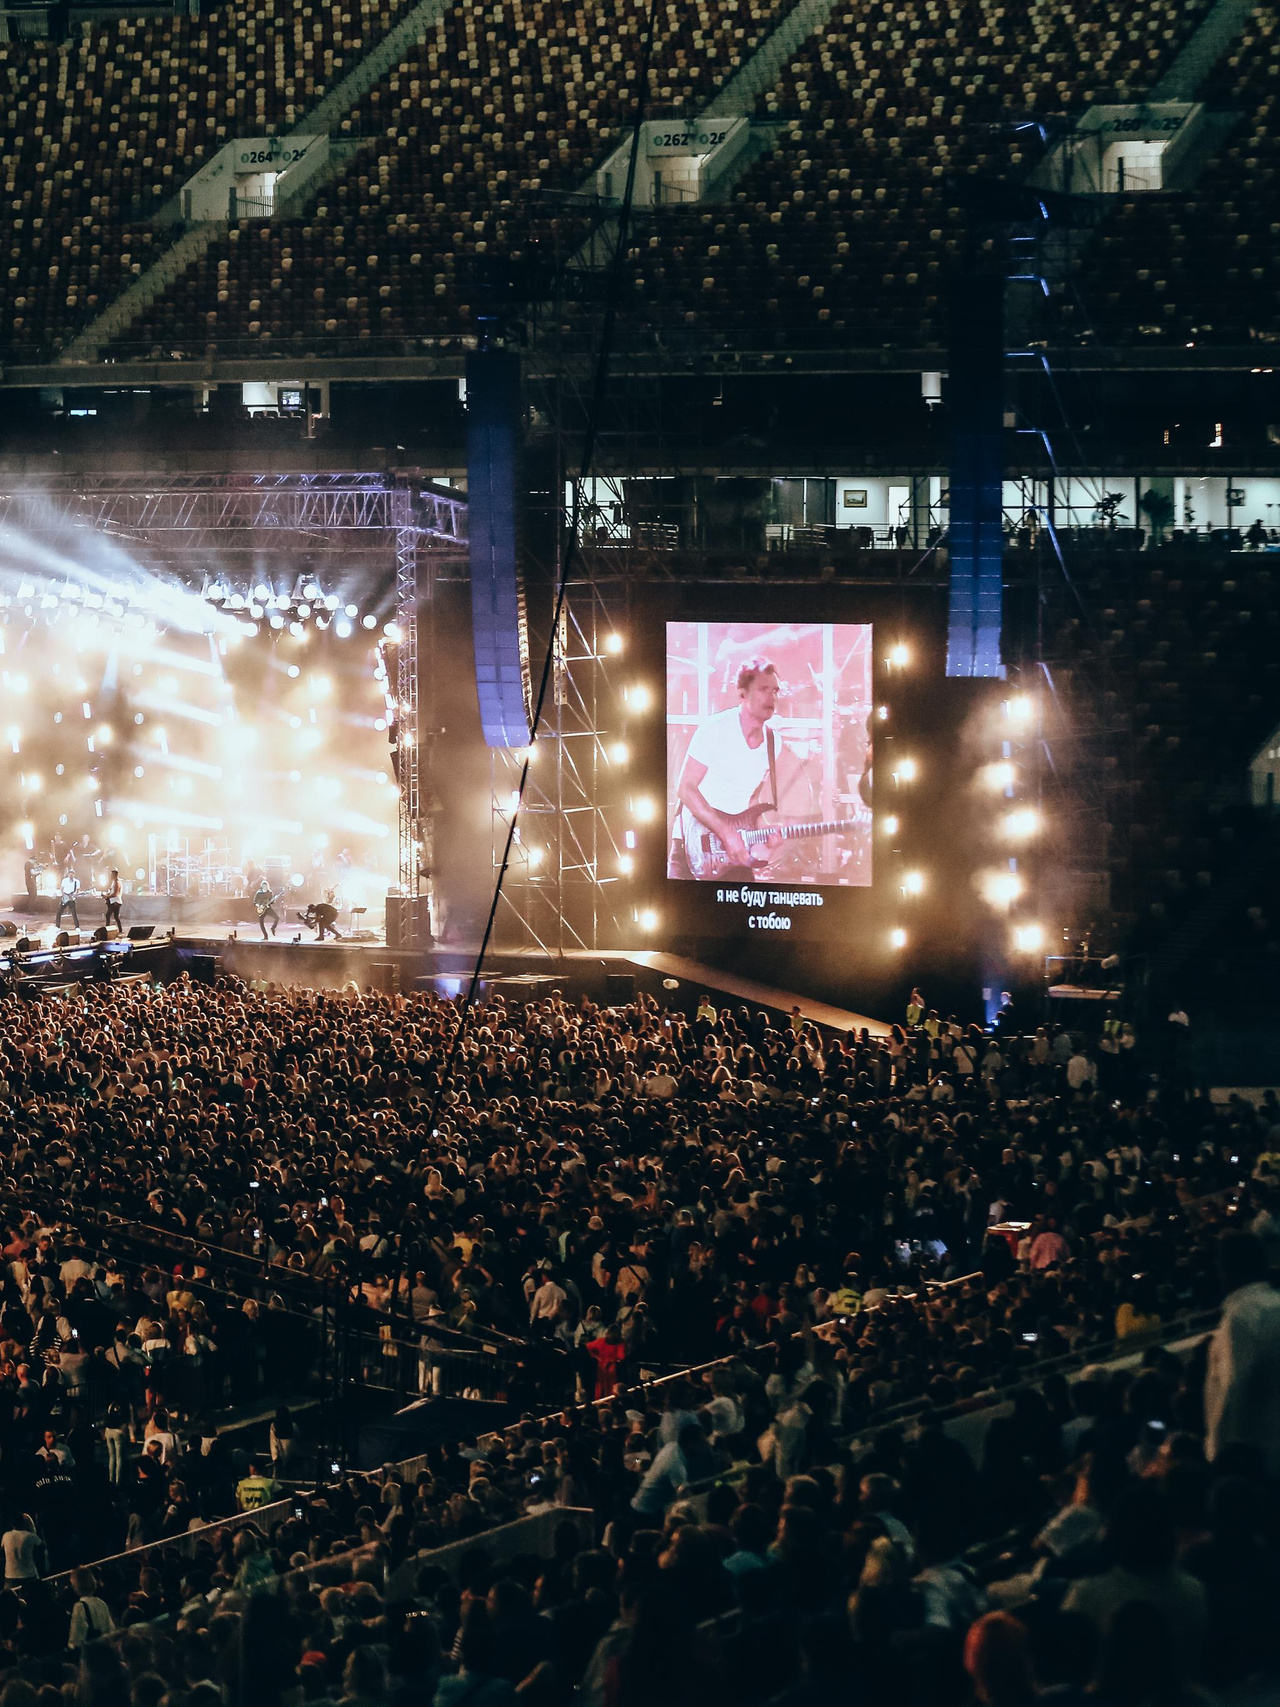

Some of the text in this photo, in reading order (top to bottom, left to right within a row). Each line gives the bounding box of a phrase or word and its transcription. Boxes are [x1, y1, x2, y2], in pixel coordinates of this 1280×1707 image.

[664, 132, 726, 146] 262 26
[250, 151, 273, 163] 264
[716, 886, 824, 908] я не буду танцевать
[748, 912, 792, 930] с тобою
